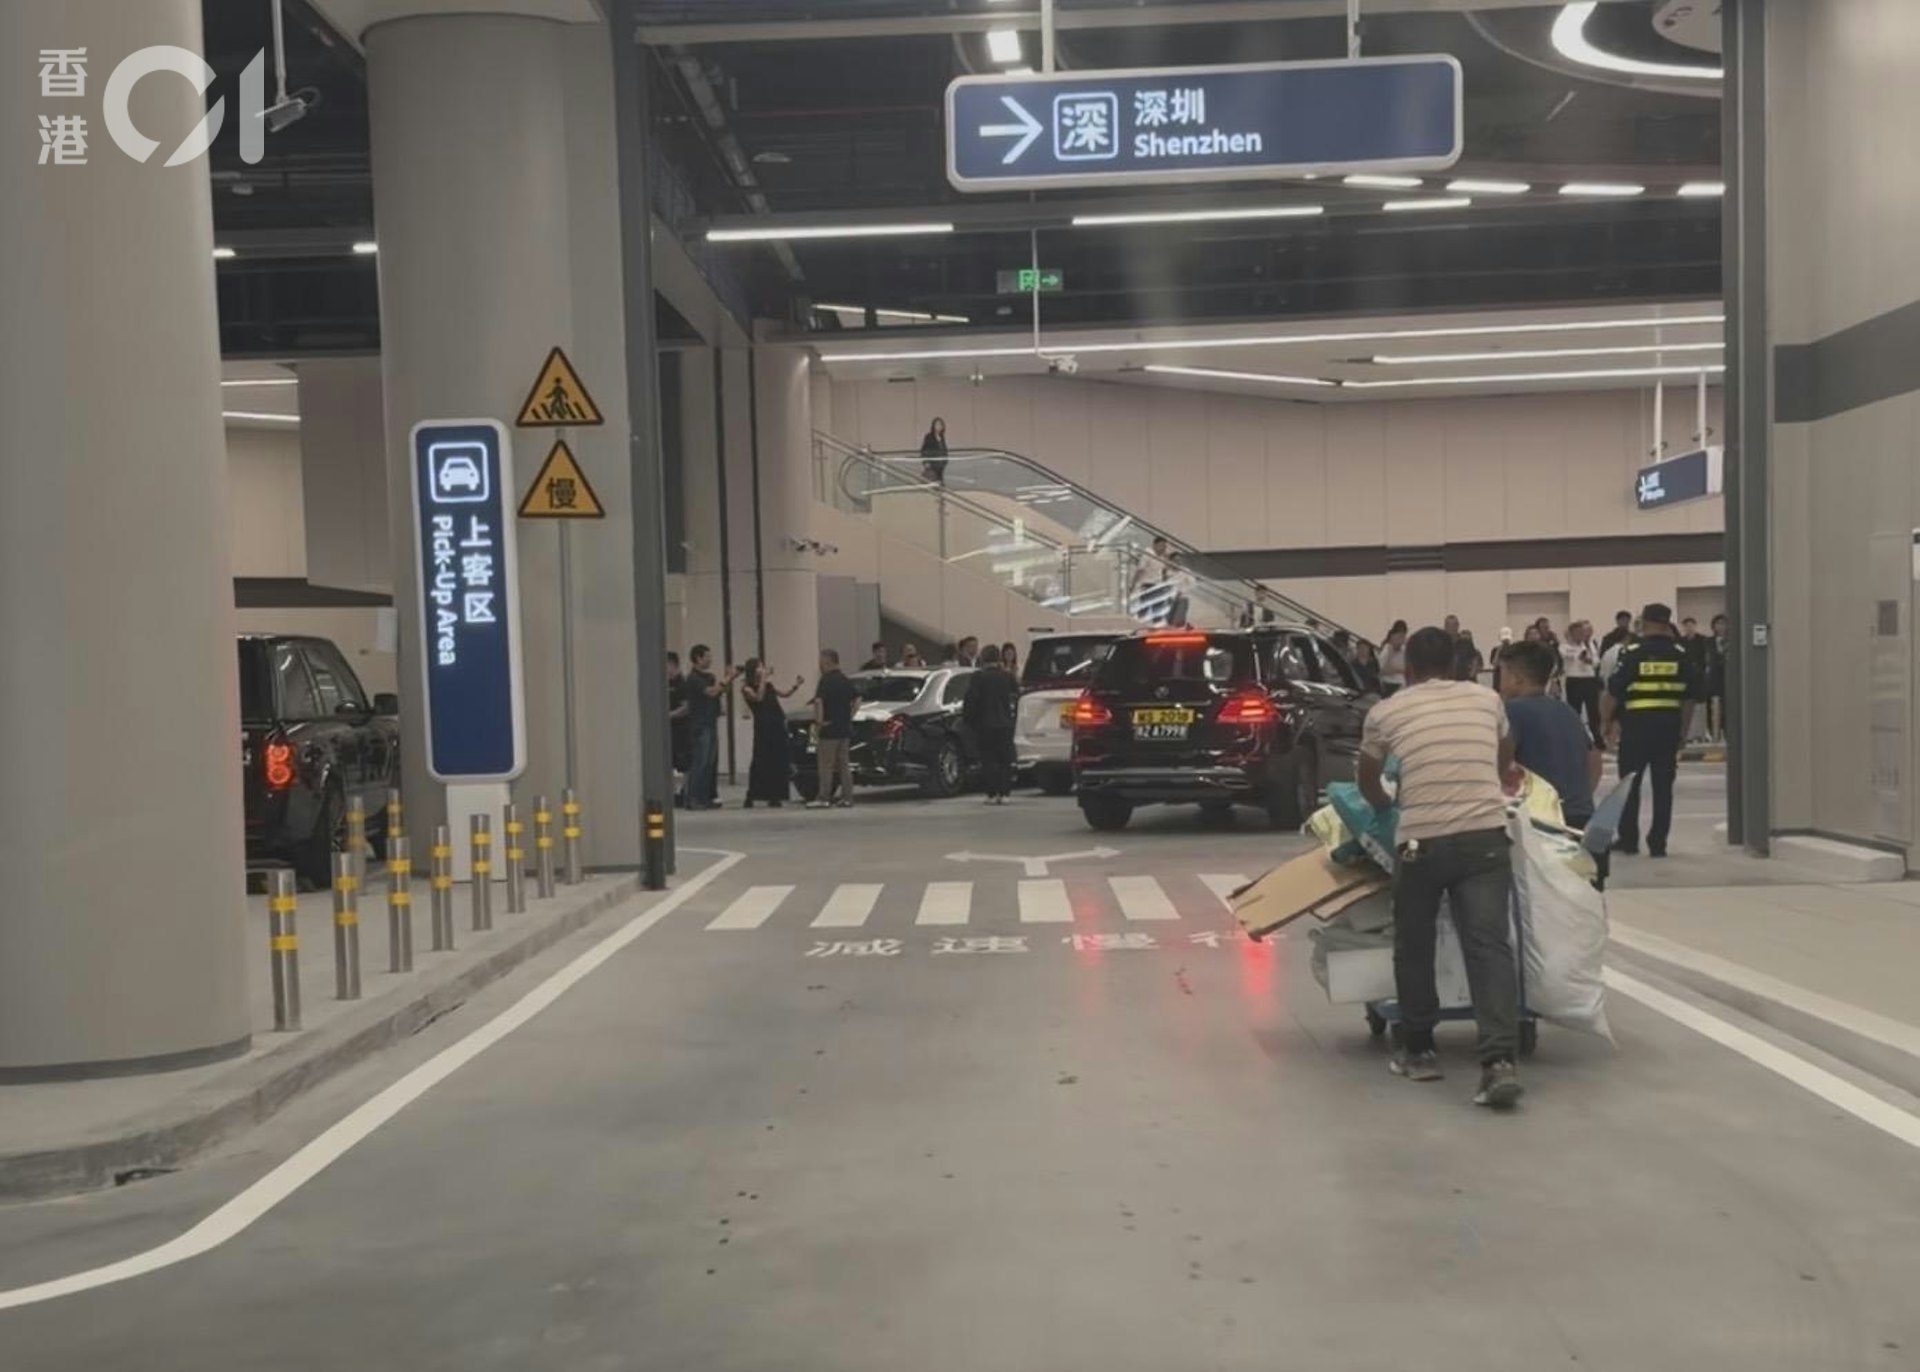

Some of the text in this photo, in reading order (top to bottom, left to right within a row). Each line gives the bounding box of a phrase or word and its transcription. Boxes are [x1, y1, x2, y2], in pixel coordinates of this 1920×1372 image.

[1061, 102, 1109, 151] 深
[1133, 88, 1206, 127] 深圳
[1133, 129, 1263, 158] Shenzhen
[545, 476, 577, 509] 慢
[430, 515, 458, 666] Pick-Up Area
[459, 514, 497, 623] 上客区
